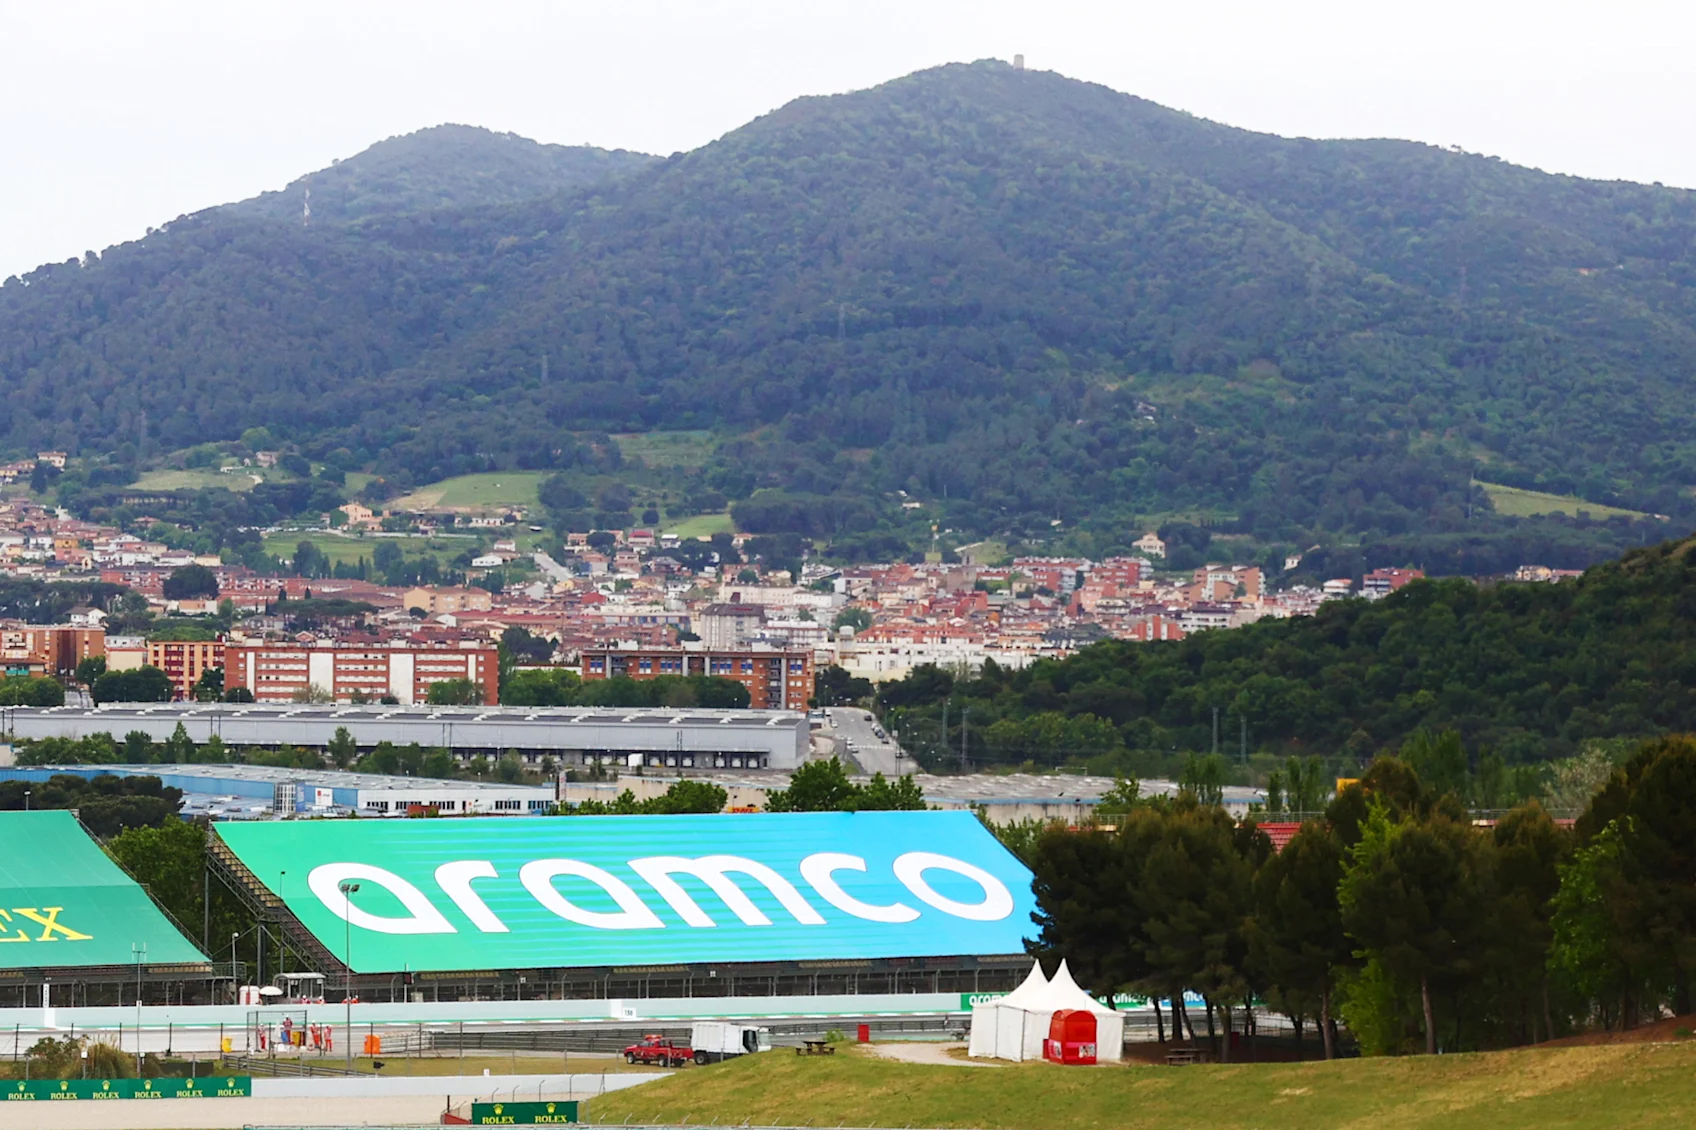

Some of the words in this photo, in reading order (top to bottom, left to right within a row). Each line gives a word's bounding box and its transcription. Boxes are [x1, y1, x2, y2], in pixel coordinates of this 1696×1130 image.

[307, 852, 1015, 935] aramco
[8, 1092, 36, 1101] ROLEX
[50, 1092, 78, 1100] ROLEX
[92, 1091, 120, 1099] ROLEX
[134, 1091, 162, 1099] ROLEX
[176, 1089, 203, 1098] ROLEX
[217, 1088, 245, 1097] ROLEX
[482, 1116, 515, 1125] ROLEX
[534, 1115, 567, 1123] ROLEX
